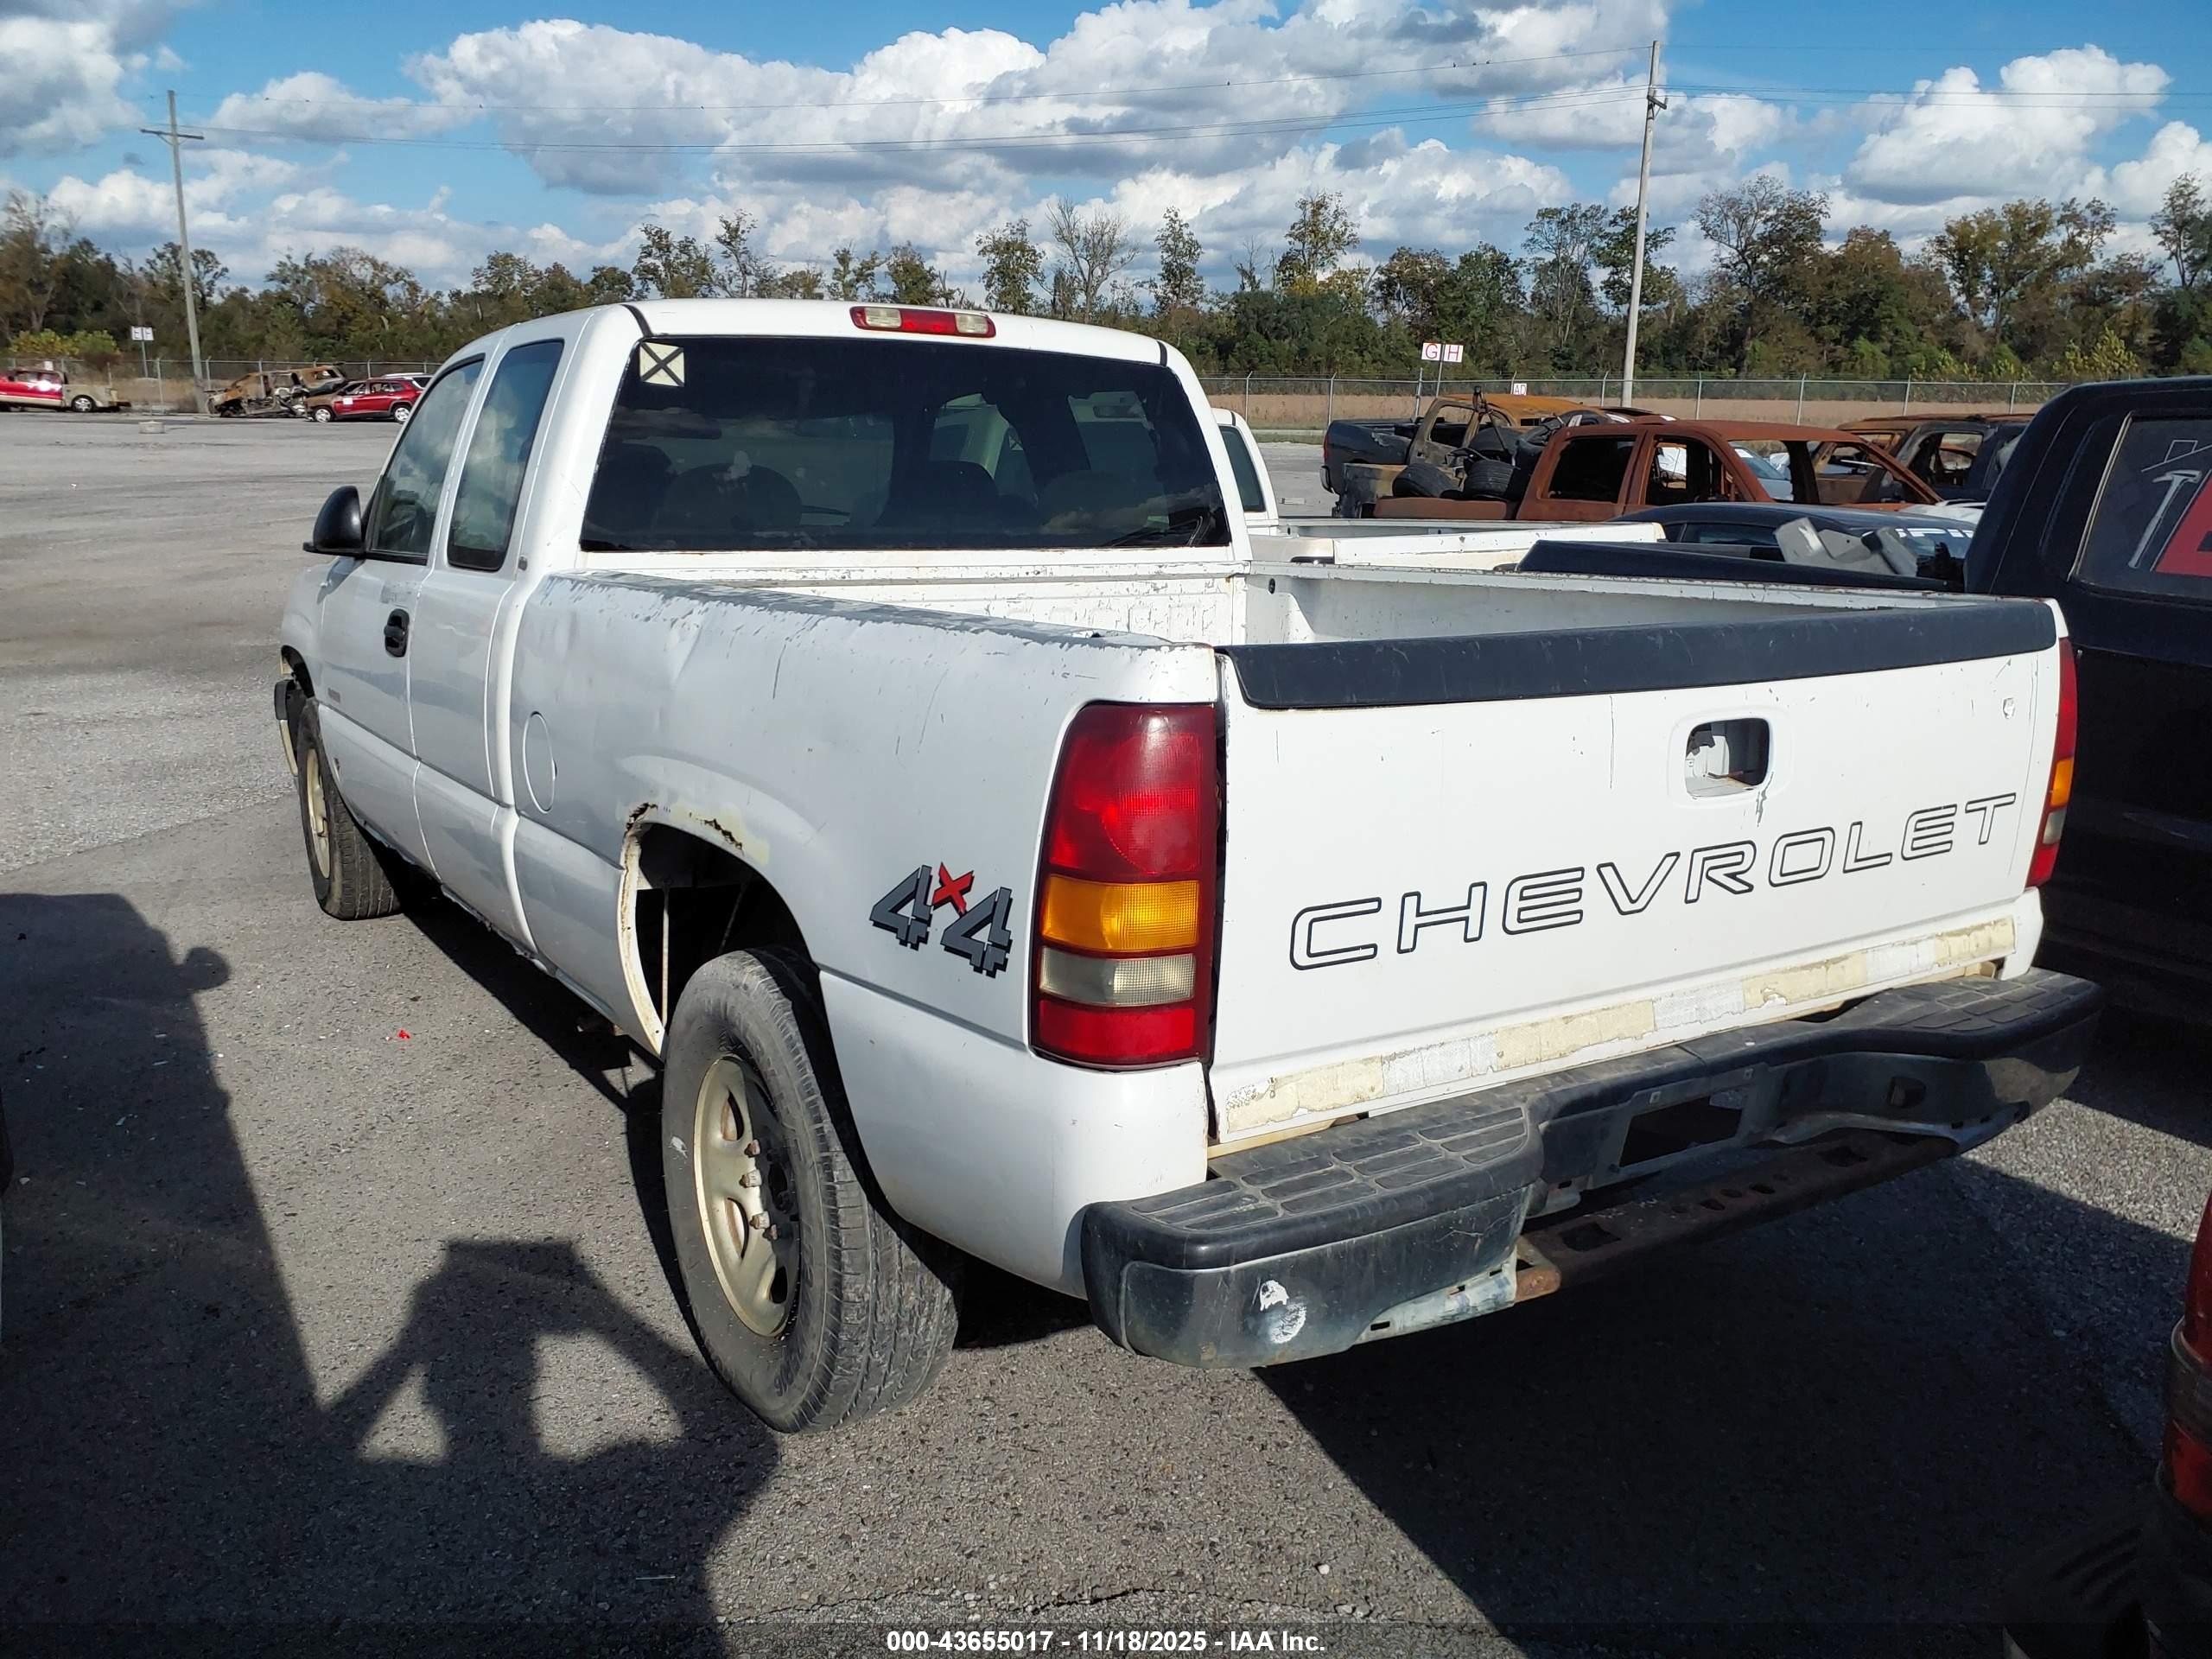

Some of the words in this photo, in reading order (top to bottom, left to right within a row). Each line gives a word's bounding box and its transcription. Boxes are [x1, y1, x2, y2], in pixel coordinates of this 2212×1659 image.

[1426, 343, 1438, 359] G
[1447, 345, 1460, 361] H
[1290, 792, 2017, 971] CHEVROLET
